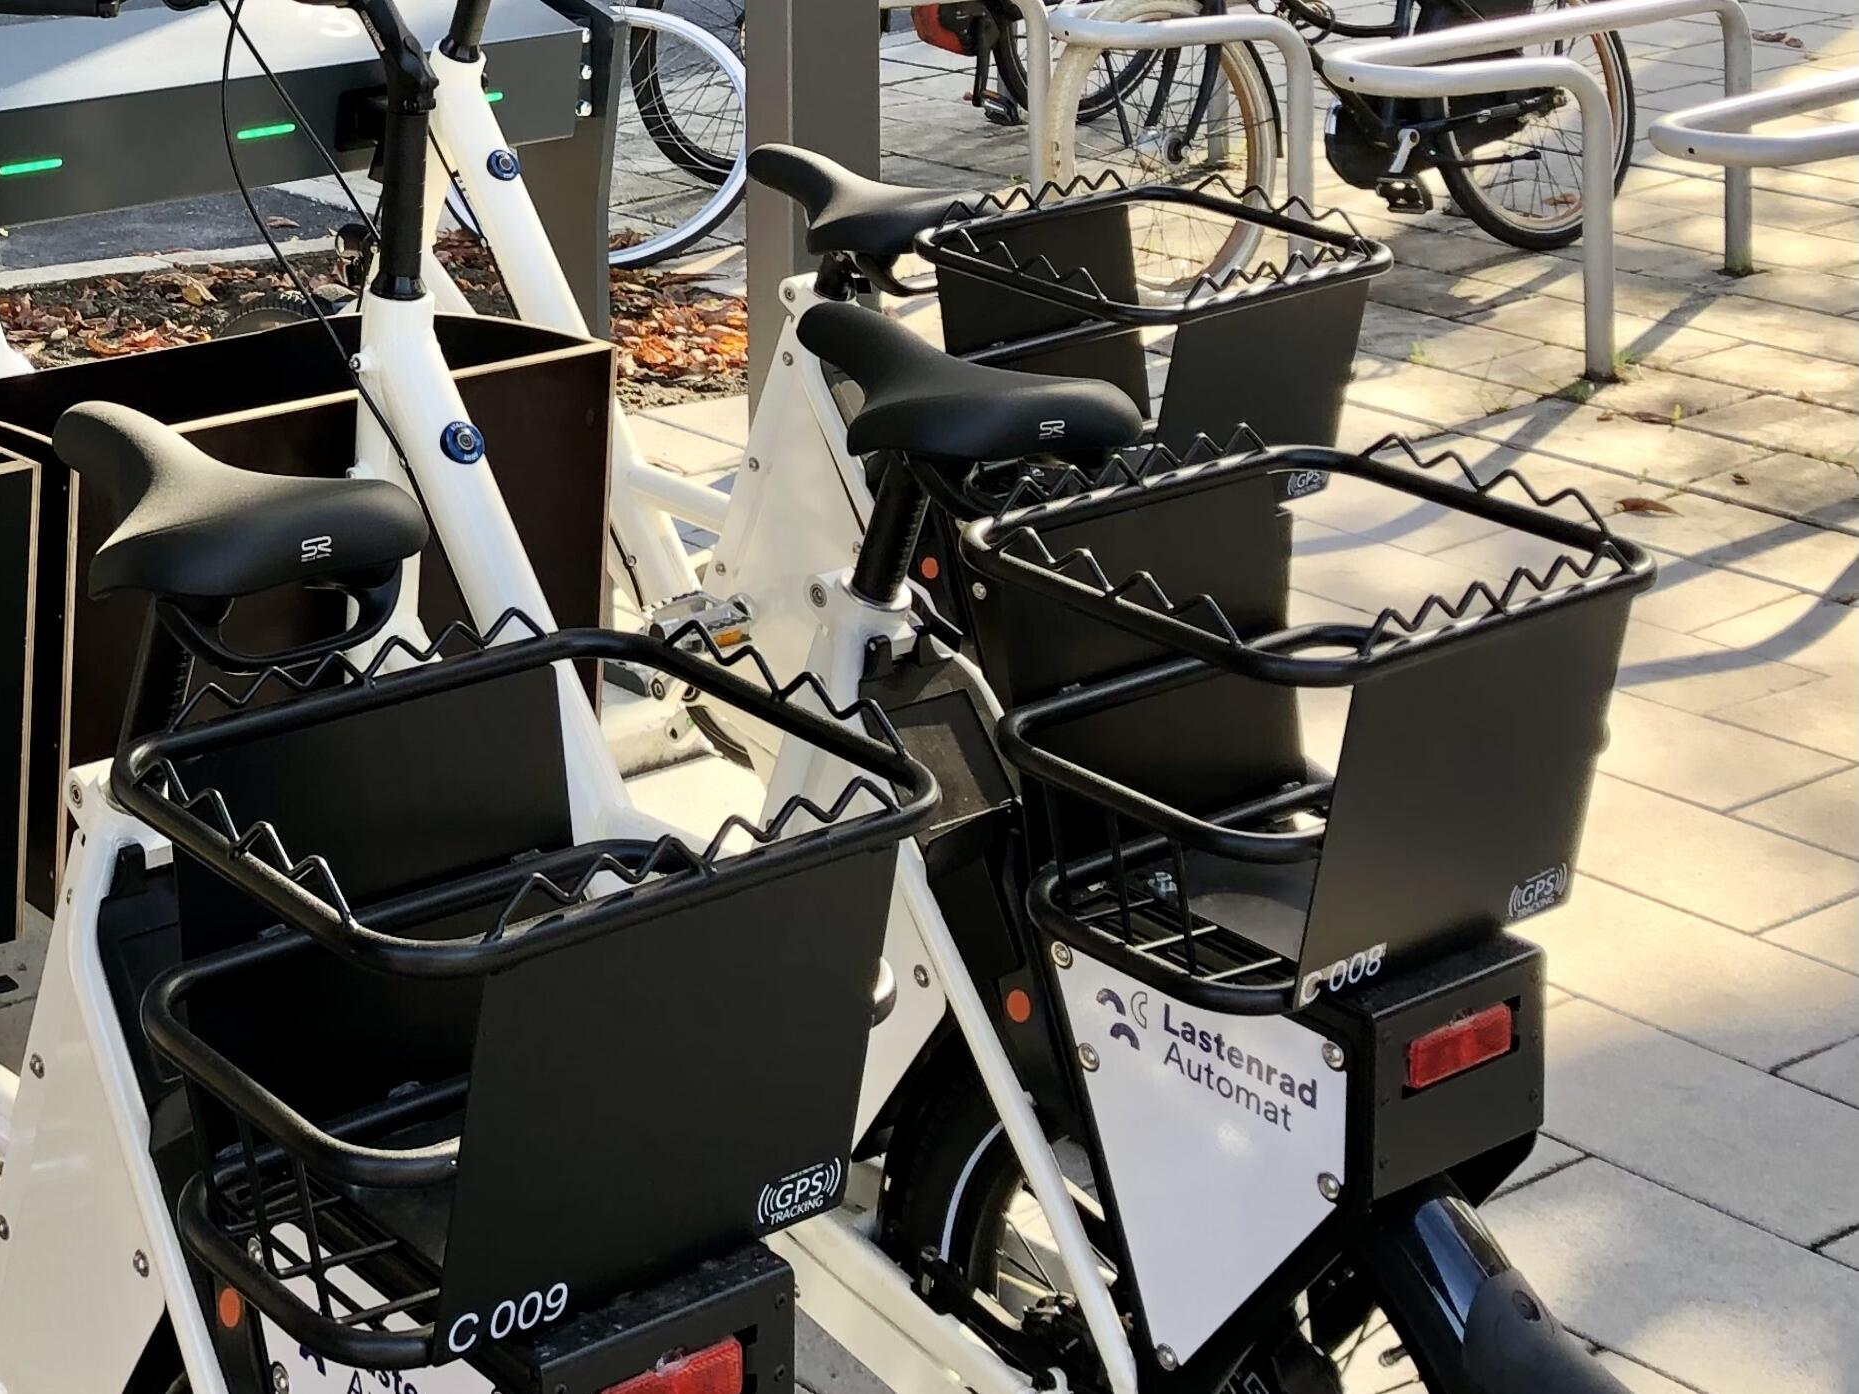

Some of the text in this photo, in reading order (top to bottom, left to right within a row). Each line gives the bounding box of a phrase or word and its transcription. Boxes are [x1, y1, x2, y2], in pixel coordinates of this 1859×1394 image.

[1521, 874, 1555, 906] GPS
[1300, 947, 1383, 1004] C 008
[1163, 1002, 1318, 1110] Lastenrad
[1163, 1041, 1292, 1132] Automat
[770, 1194, 824, 1226] TRACKING
[775, 1171, 824, 1209] GPS
[448, 1282, 568, 1353] C 009
